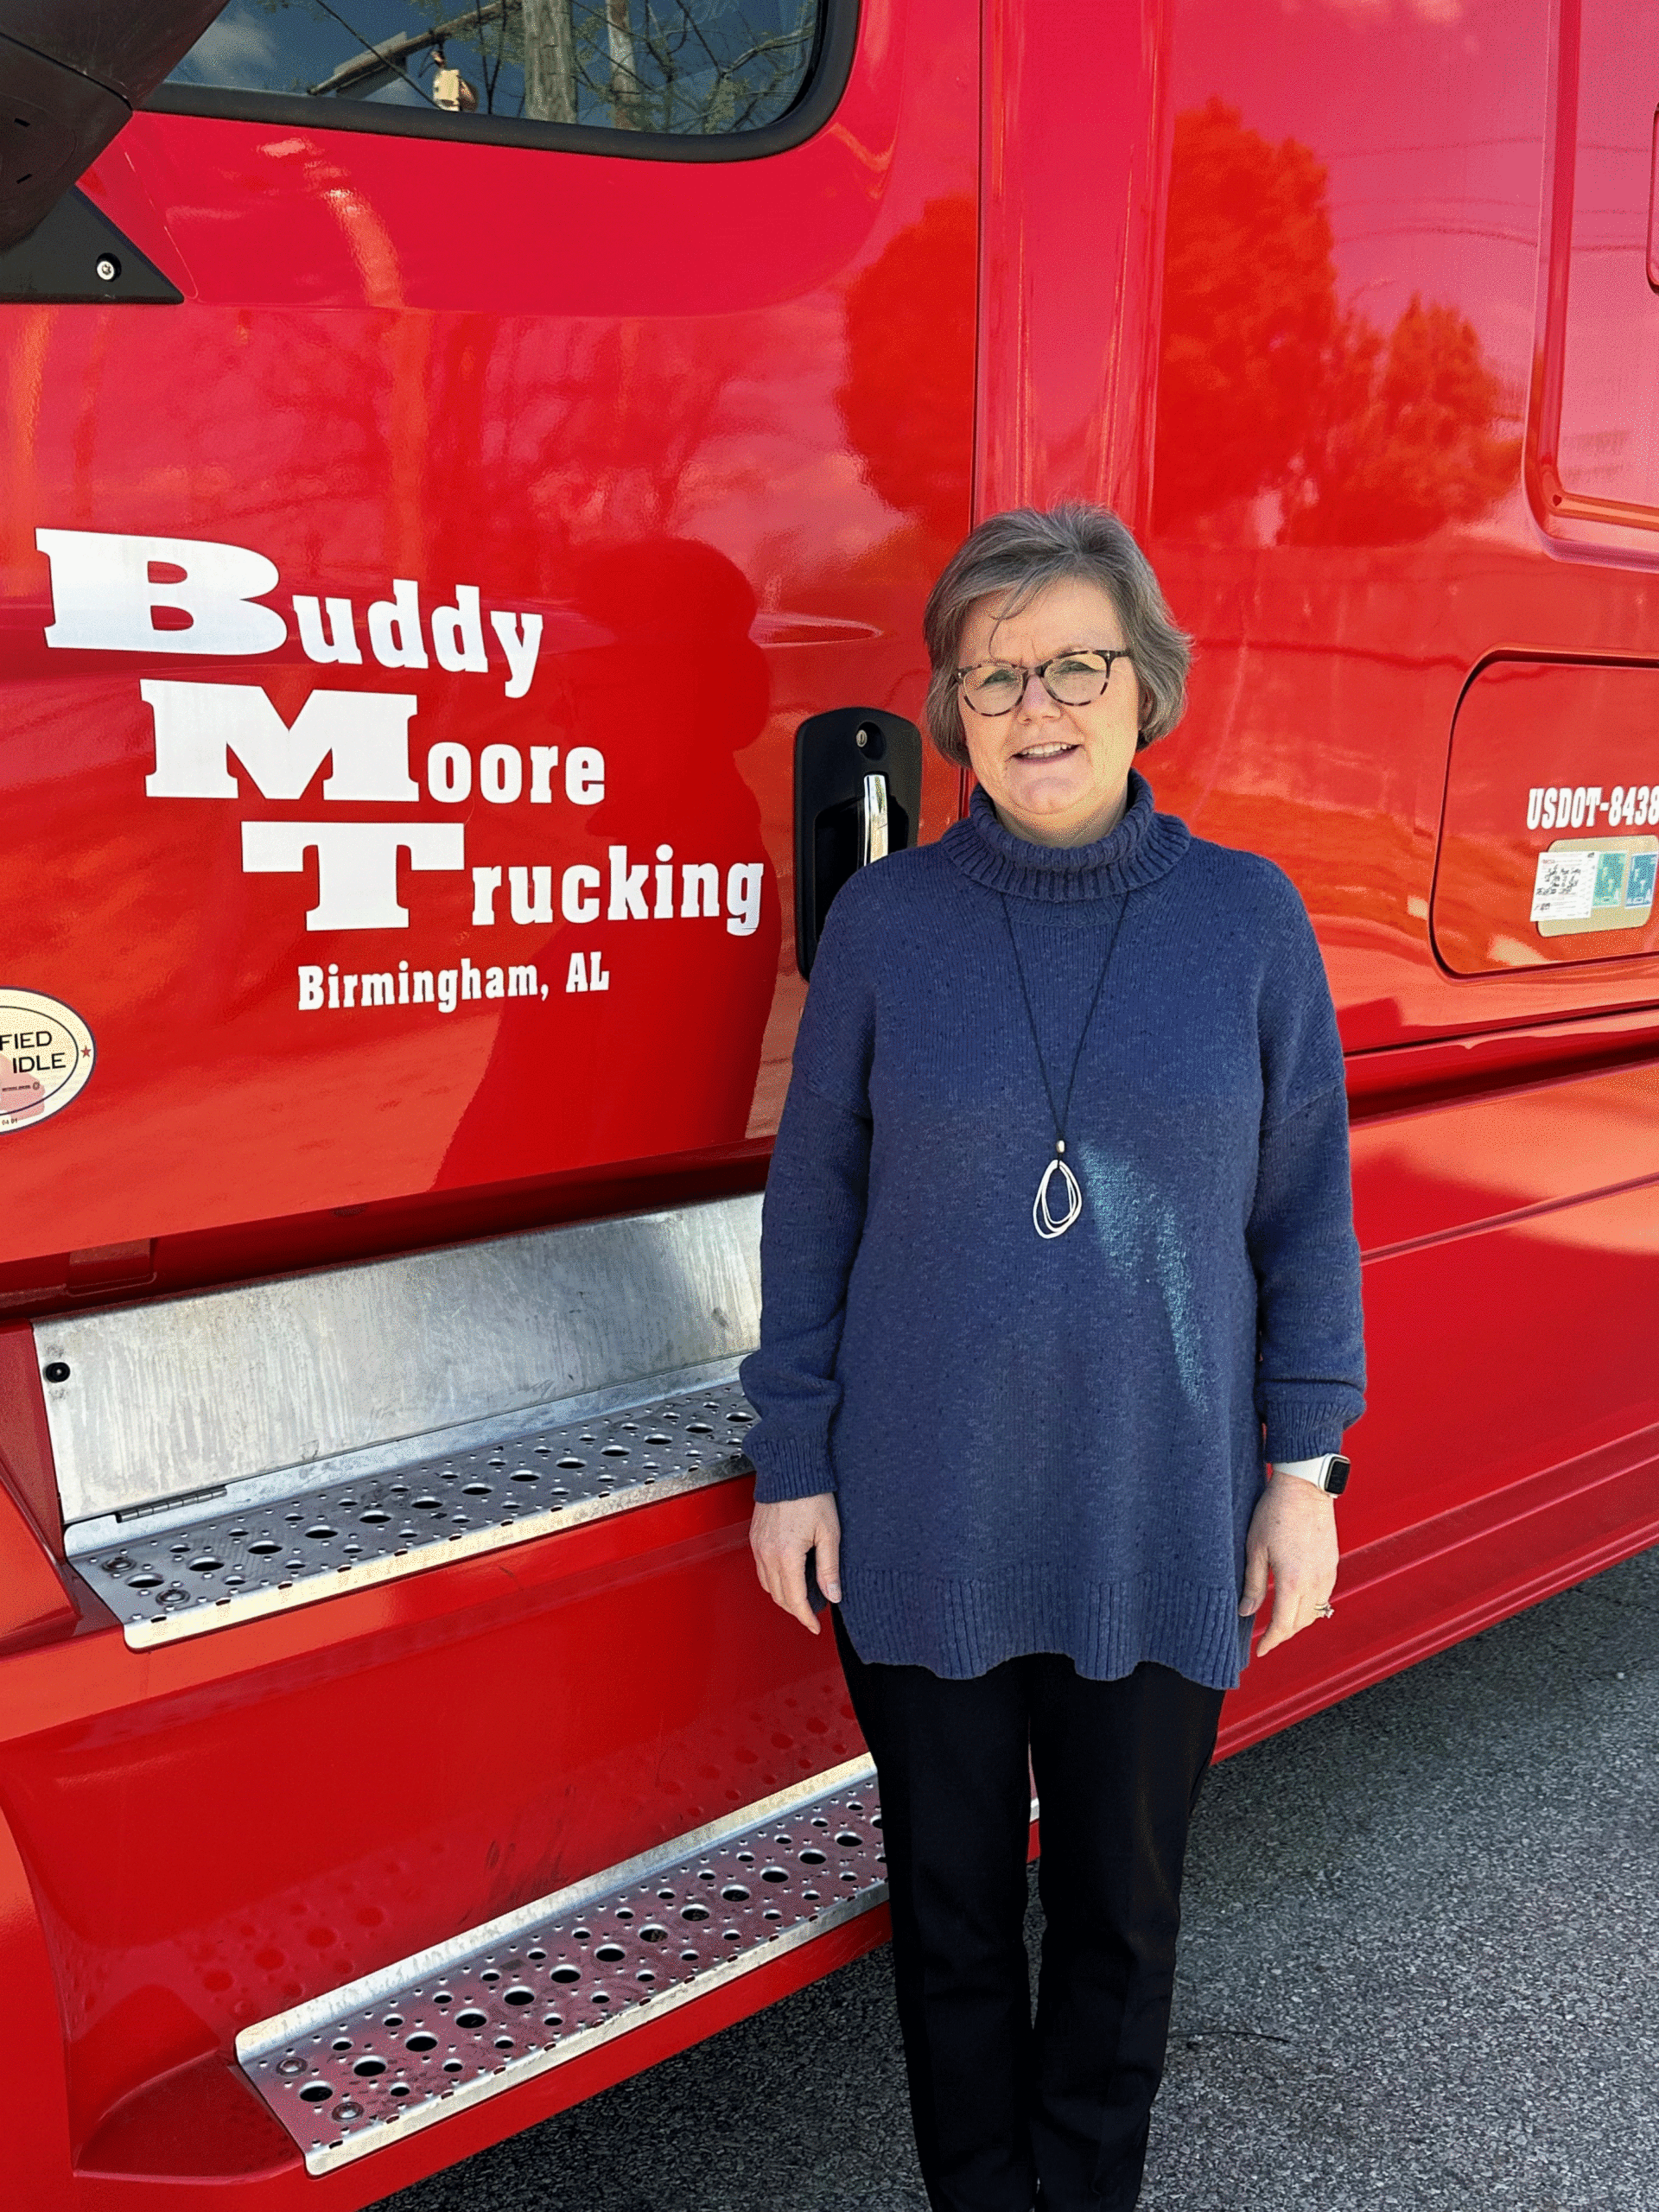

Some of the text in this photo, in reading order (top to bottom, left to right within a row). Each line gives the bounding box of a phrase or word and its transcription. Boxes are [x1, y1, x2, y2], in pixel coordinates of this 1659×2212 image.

[35, 527, 543, 698] Buddy
[140, 678, 606, 805] Moore
[1526, 785, 1659, 830] USDOT-8438
[241, 821, 764, 935] Trucking
[298, 951, 610, 1014] Birmingham, AL
[12, 1052, 67, 1074] IDLE
